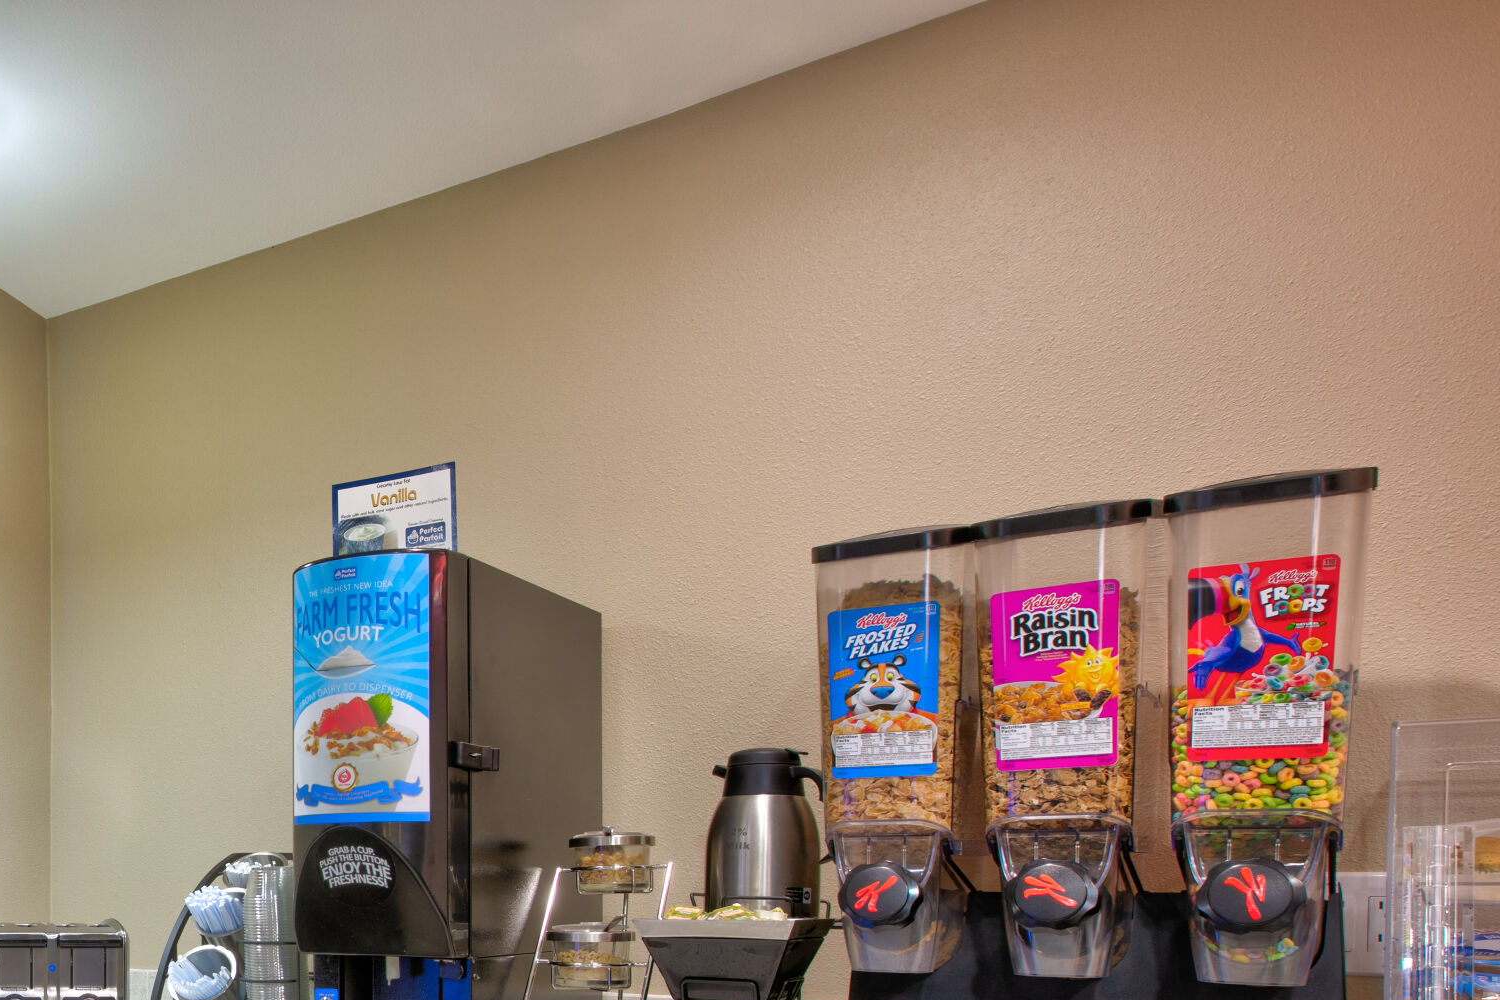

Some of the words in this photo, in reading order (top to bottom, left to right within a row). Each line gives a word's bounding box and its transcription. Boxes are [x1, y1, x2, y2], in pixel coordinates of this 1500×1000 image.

[370, 487, 417, 508] Vanilla
[419, 525, 444, 535] Perfect
[419, 533, 444, 543] Parfait
[1267, 568, 1319, 584] Kellogg's
[309, 590, 319, 598] THE
[320, 584, 351, 595] FRESHEST
[353, 582, 372, 591] NEW
[374, 579, 393, 589] IDEA
[1259, 583, 1330, 605] FROOT
[1022, 592, 1082, 612] Kellogg's
[1264, 598, 1328, 618] LOOPS
[346, 591, 421, 634] FRESH
[856, 611, 908, 629] Kellogg's
[1011, 607, 1098, 640] Raisin
[312, 625, 385, 649] YOGURT
[844, 623, 917, 649] FROSTED
[1020, 629, 1088, 657] Bran
[849, 636, 911, 659] FLAKES
[317, 685, 341, 697] DAIRY
[344, 682, 357, 691] TO
[359, 682, 413, 701] DISPENSER
[328, 846, 349, 856] GRAB
[350, 846, 356, 854] A
[357, 846, 376, 856] CUP.
[319, 855, 339, 869] PUSH
[339, 854, 354, 862] THE
[354, 854, 391, 868] BUTTON.
[322, 862, 361, 881] ENJOY
[362, 862, 393, 881] THE
[329, 874, 389, 889] FRESHNESS!
